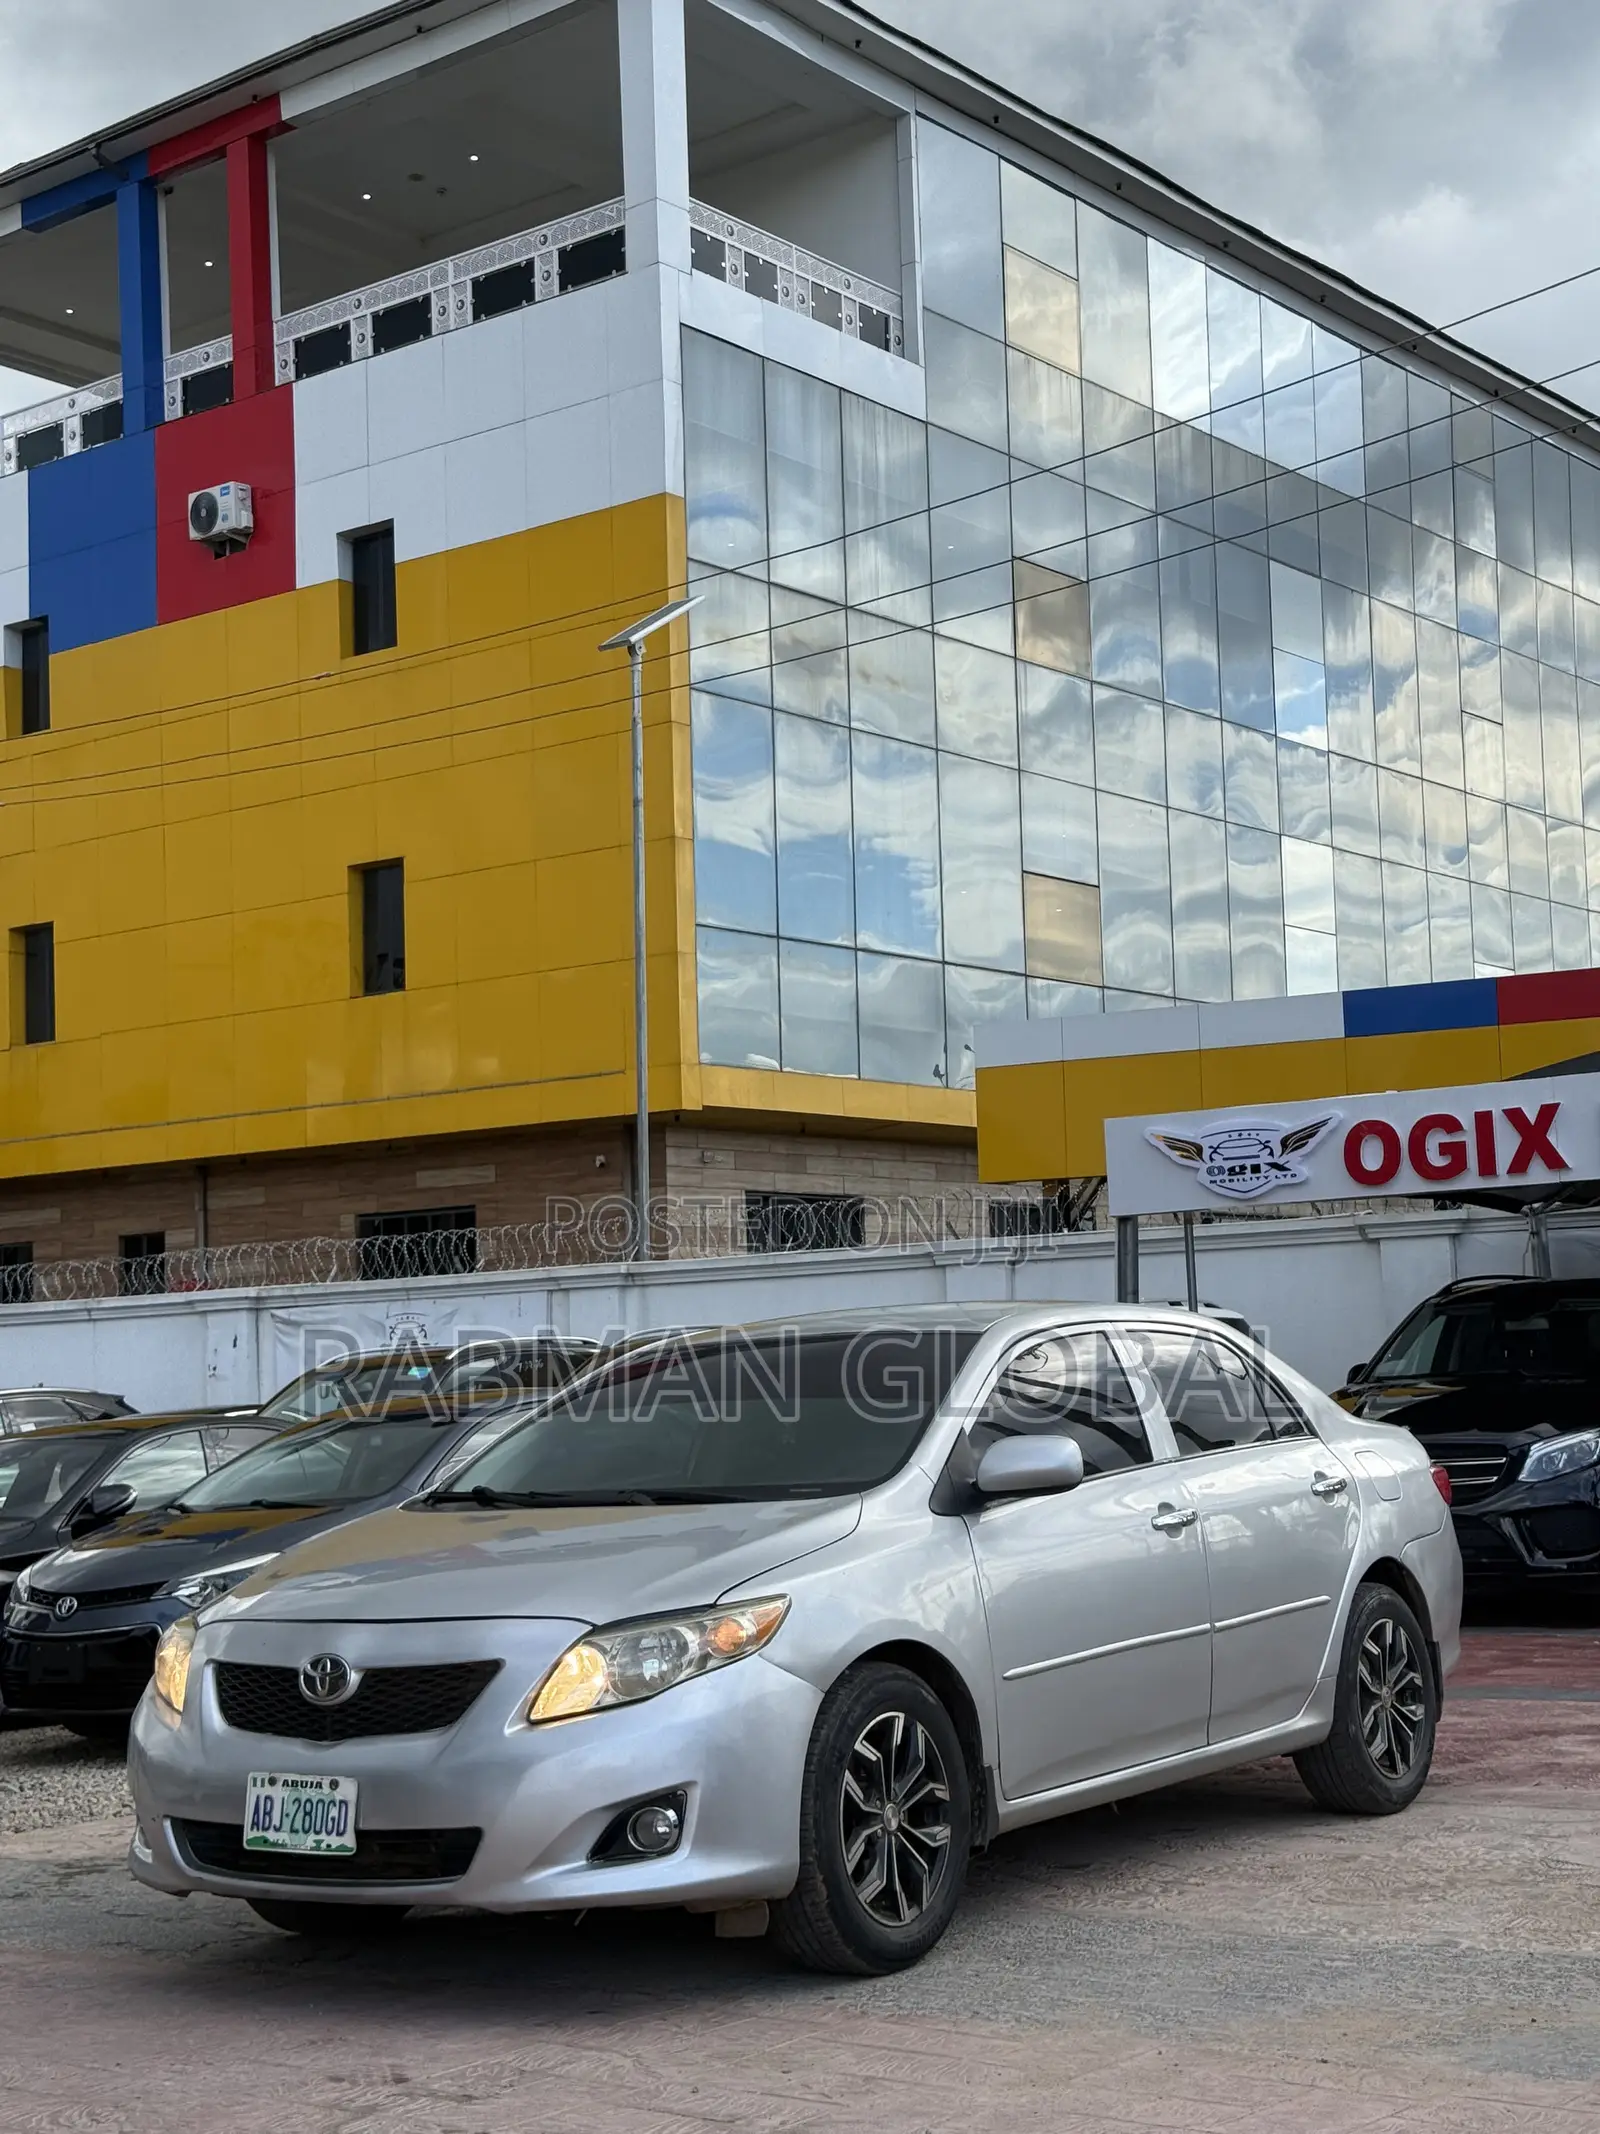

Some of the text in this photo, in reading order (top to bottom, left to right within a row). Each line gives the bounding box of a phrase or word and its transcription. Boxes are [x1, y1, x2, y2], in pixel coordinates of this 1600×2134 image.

[1343, 1102, 1573, 1187] OGIX
[1209, 1175, 1270, 1184] MOBILITY
[281, 1779, 324, 1790] ABUJA
